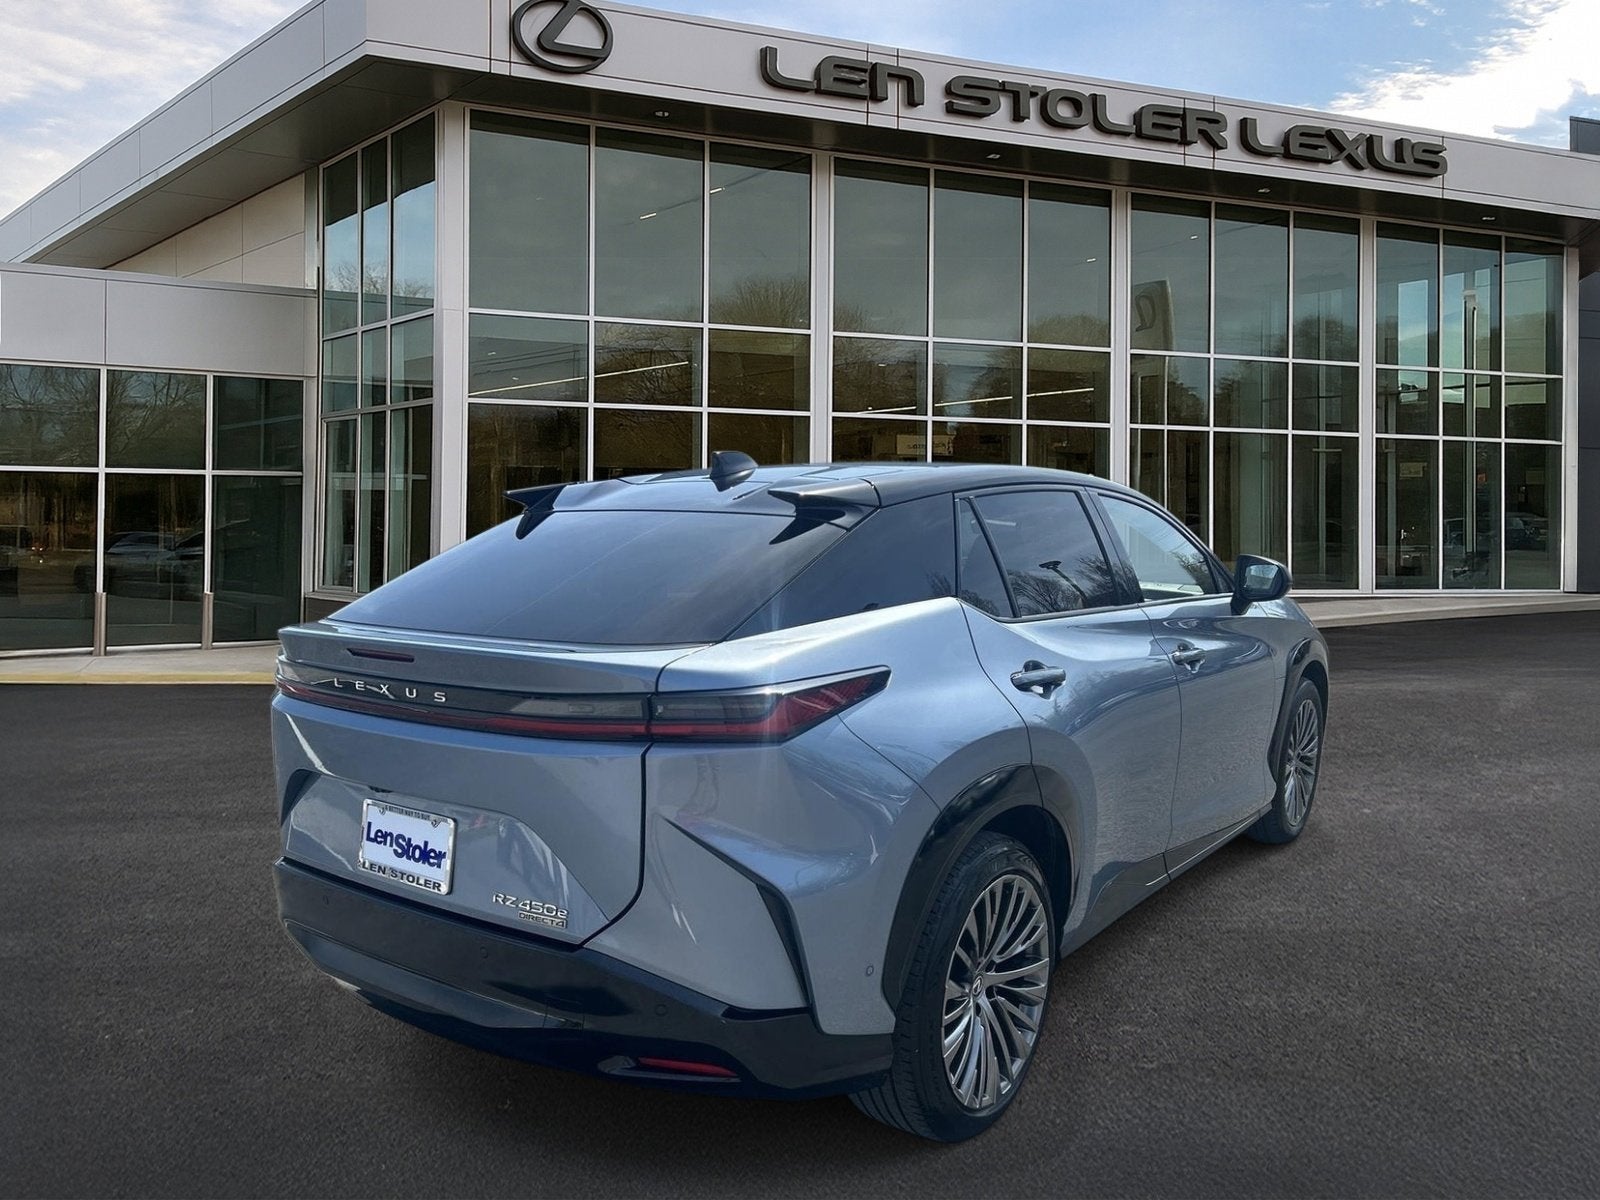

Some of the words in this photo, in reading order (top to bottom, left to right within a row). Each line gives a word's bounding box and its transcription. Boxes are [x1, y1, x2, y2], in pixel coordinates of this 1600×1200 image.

[760, 45, 924, 107] LEN
[945, 74, 1227, 151] STOLER
[1239, 116, 1448, 178] LEXUS
[334, 677, 446, 703] LEXUS
[361, 860, 386, 875] LEN
[390, 867, 442, 893] STOLER
